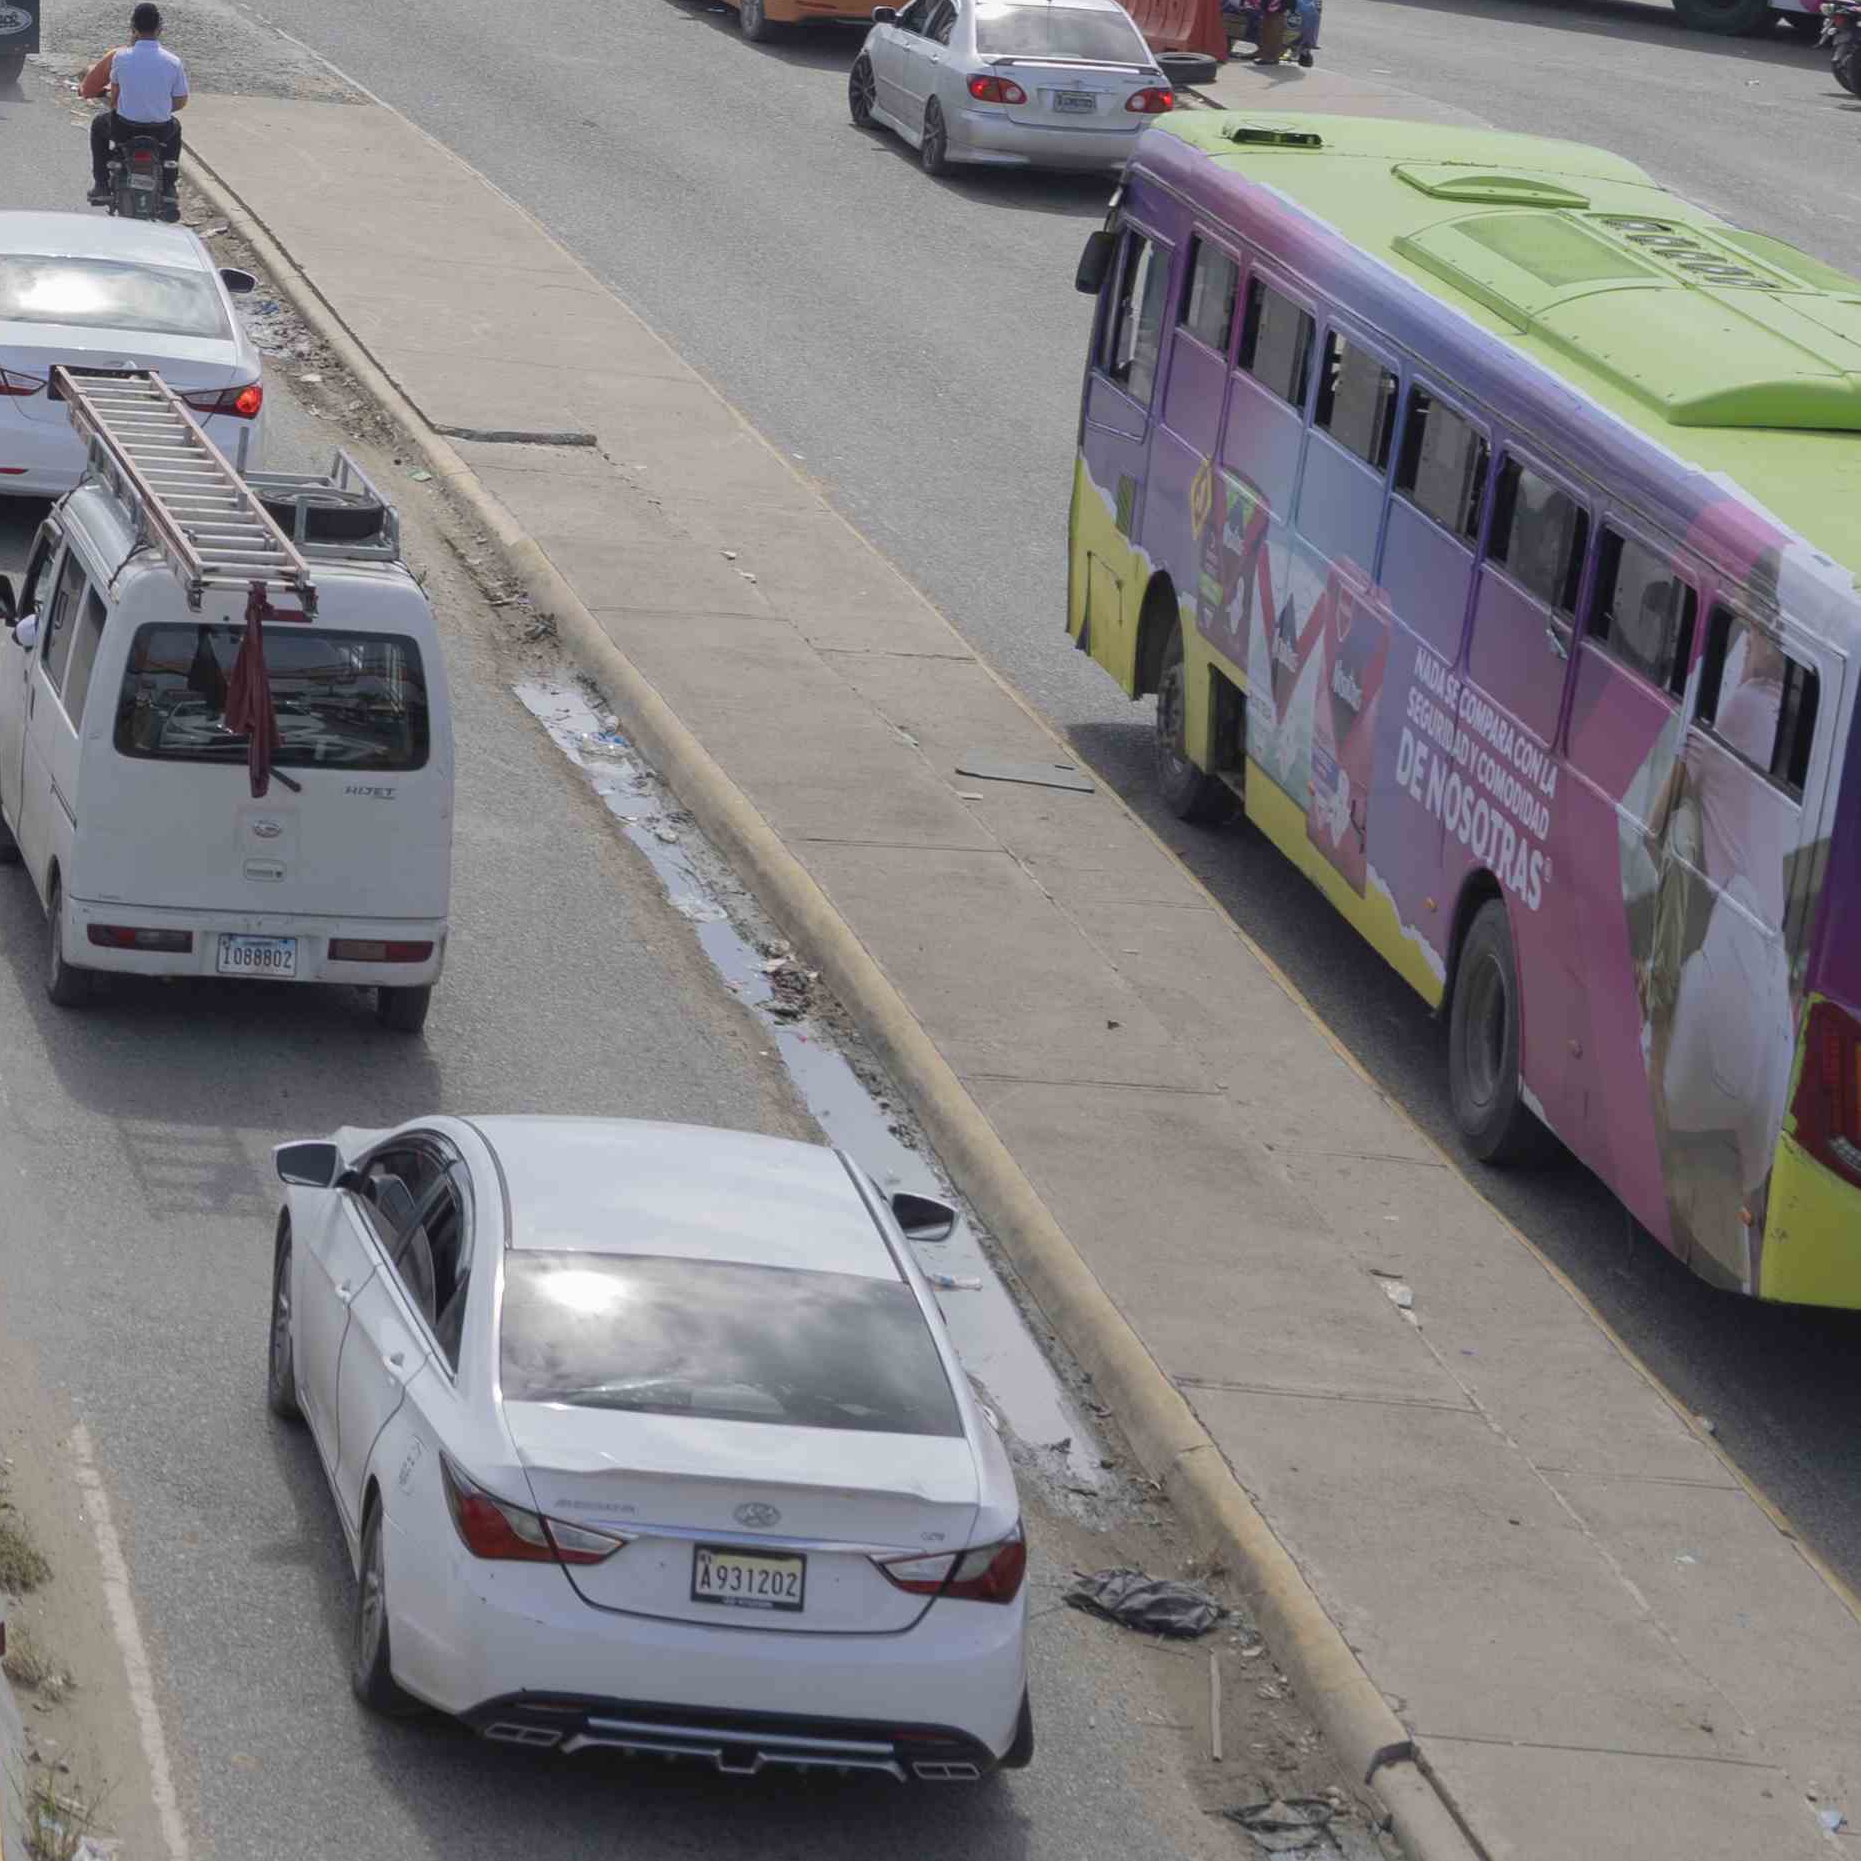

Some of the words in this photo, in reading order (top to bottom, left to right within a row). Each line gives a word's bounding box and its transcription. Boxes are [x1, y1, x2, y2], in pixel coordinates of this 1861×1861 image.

[1406, 685, 1470, 767] SEGURIDAD
[1468, 743, 1479, 776] Y
[1476, 751, 1550, 842] COMODIDAD
[1414, 644, 1446, 697] NADA
[1443, 673, 1461, 709] SE
[1457, 687, 1516, 760] COMPARA
[1512, 736, 1544, 784] CON
[1538, 757, 1558, 800] LA
[1395, 725, 1429, 803] DE
[1424, 754, 1544, 911] NOSOTRAS
[699, 1563, 799, 1598] A931202
